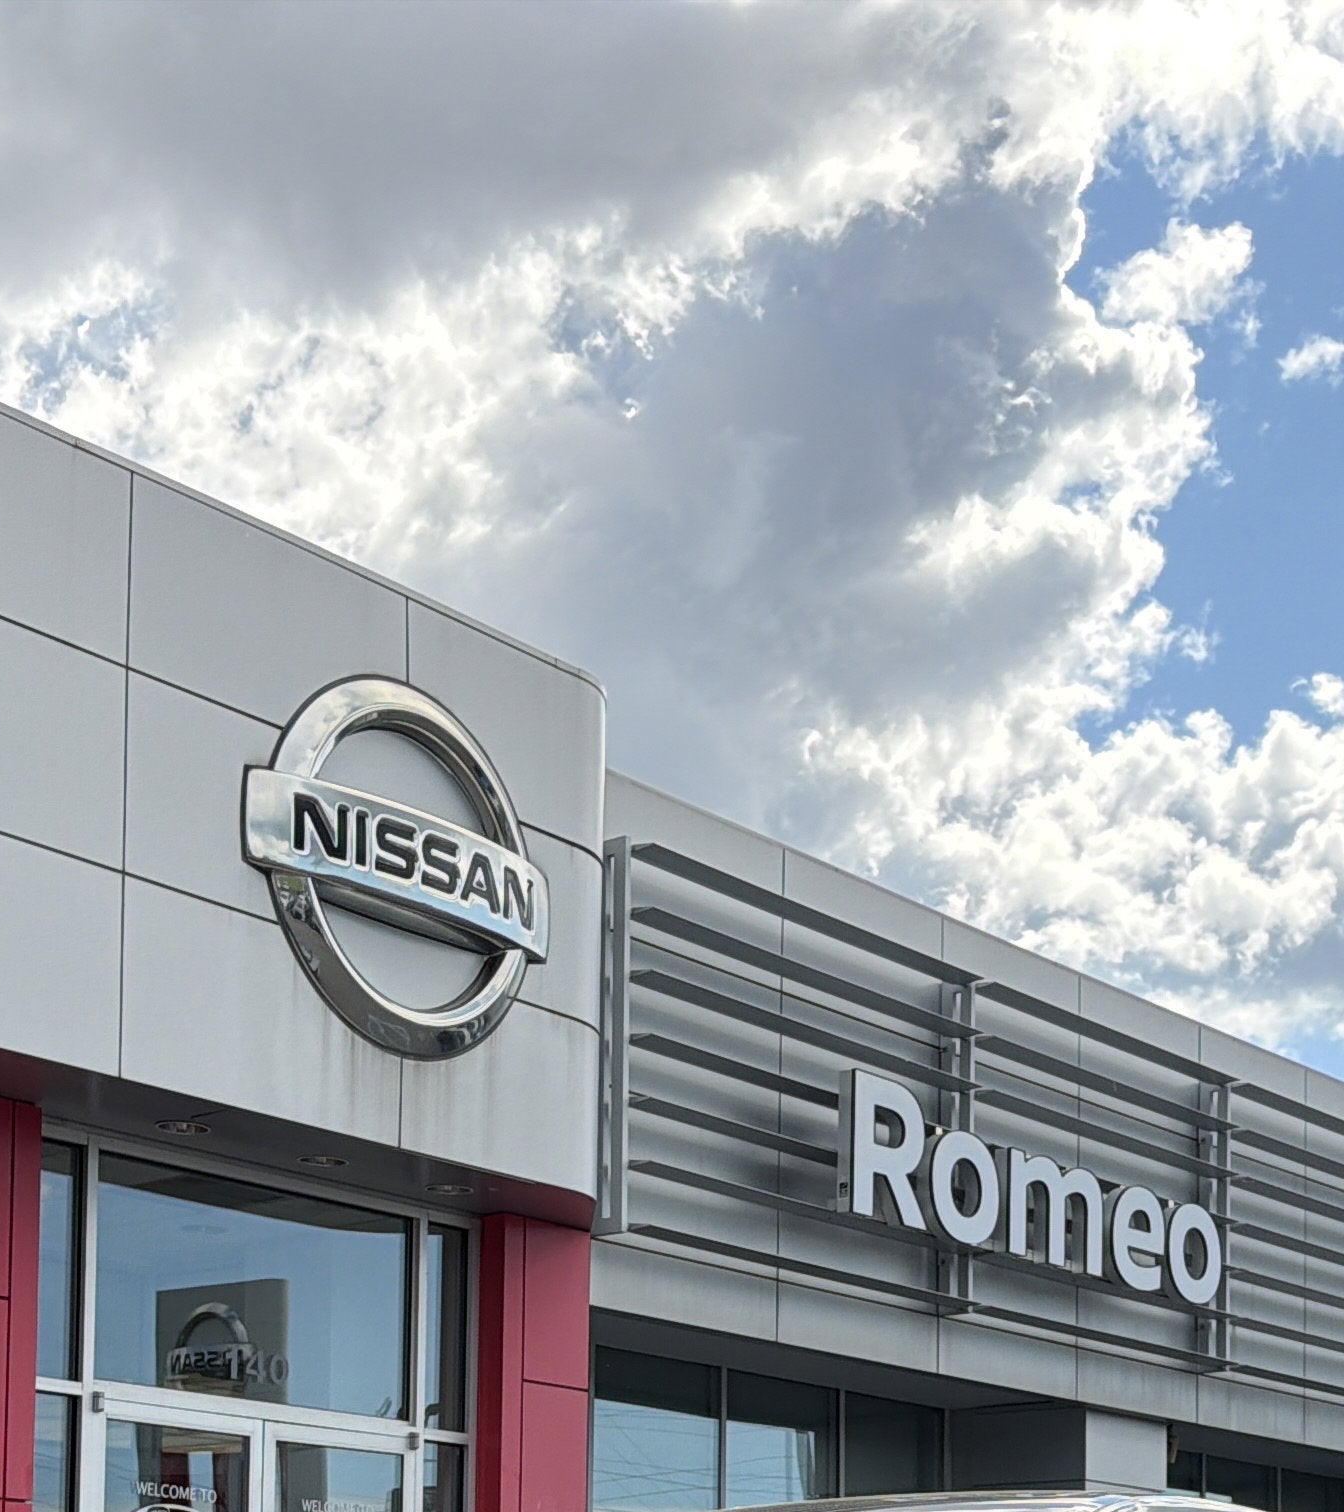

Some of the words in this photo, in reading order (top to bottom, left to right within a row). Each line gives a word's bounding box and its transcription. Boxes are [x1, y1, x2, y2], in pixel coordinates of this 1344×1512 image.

[292, 792, 535, 932] NISSAN
[840, 1067, 1223, 1305] Romeo
[225, 1344, 289, 1385] 140
[136, 1481, 196, 1500] WELCOME
[201, 1488, 217, 1503] TO
